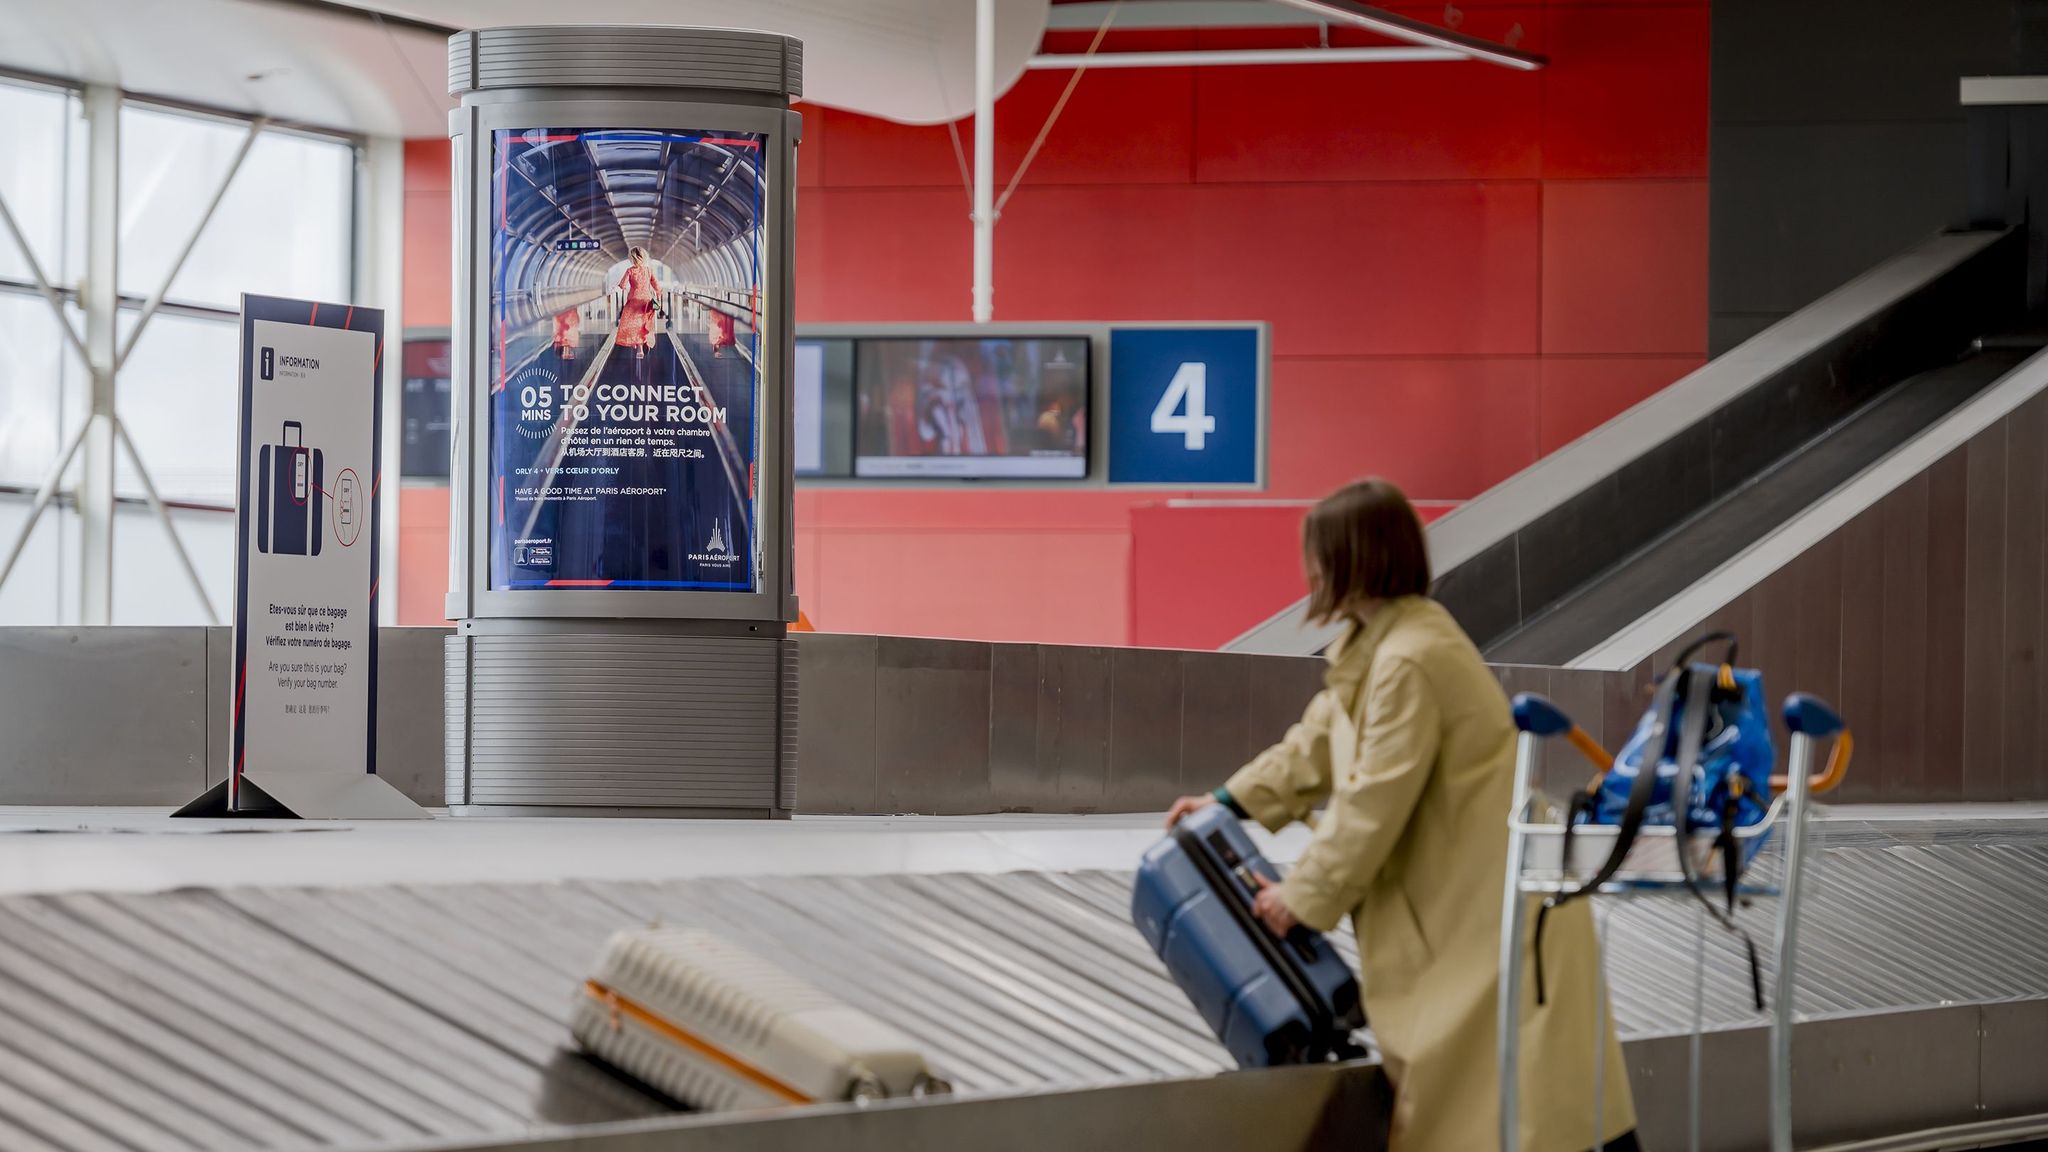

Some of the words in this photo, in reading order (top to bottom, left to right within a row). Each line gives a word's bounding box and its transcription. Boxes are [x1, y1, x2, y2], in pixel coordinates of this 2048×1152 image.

[280, 356, 319, 369] INFORMATION
[520, 386, 552, 408] 05
[560, 385, 589, 401] TO
[596, 385, 703, 403] CONNECT
[1151, 362, 1215, 450] 4
[521, 409, 551, 421] MINS
[560, 405, 589, 421] TO
[596, 405, 659, 422] YOUR
[666, 406, 727, 424] ROOM
[561, 427, 588, 435] Passez
[590, 427, 601, 435] de
[603, 427, 644, 436] l'aéroport
[646, 427, 651, 435] à
[653, 428, 675, 436] votre
[677, 428, 710, 437] chambre
[561, 437, 589, 445] d'hôtel
[616, 437, 632, 445] rien
[634, 437, 645, 445] de
[647, 438, 675, 446] temps.
[595, 487, 619, 495] PARIS
[269, 603, 297, 615] Etes-vous
[298, 604, 307, 615] sûr
[307, 607, 318, 617] que
[319, 607, 326, 616] ce
[327, 606, 348, 619] bagage
[285, 621, 294, 631] est
[295, 621, 307, 631] bien
[308, 621, 314, 631] le
[315, 622, 330, 632] vôtre
[330, 622, 334, 632] ?
[265, 635, 286, 646] Vérifiez
[287, 637, 301, 647] votre
[302, 637, 322, 647] numéro
[323, 637, 330, 647] de
[331, 638, 352, 650] bagage.
[268, 661, 278, 671] Are
[280, 663, 290, 674] you
[291, 663, 303, 672] sure
[304, 661, 314, 672] this
[315, 662, 319, 672] is
[320, 664, 333, 675] your
[333, 662, 347, 676] bag?
[277, 677, 292, 689] Verify
[294, 679, 305, 689] your
[306, 678, 316, 690] bag
[318, 678, 338, 688] number.
